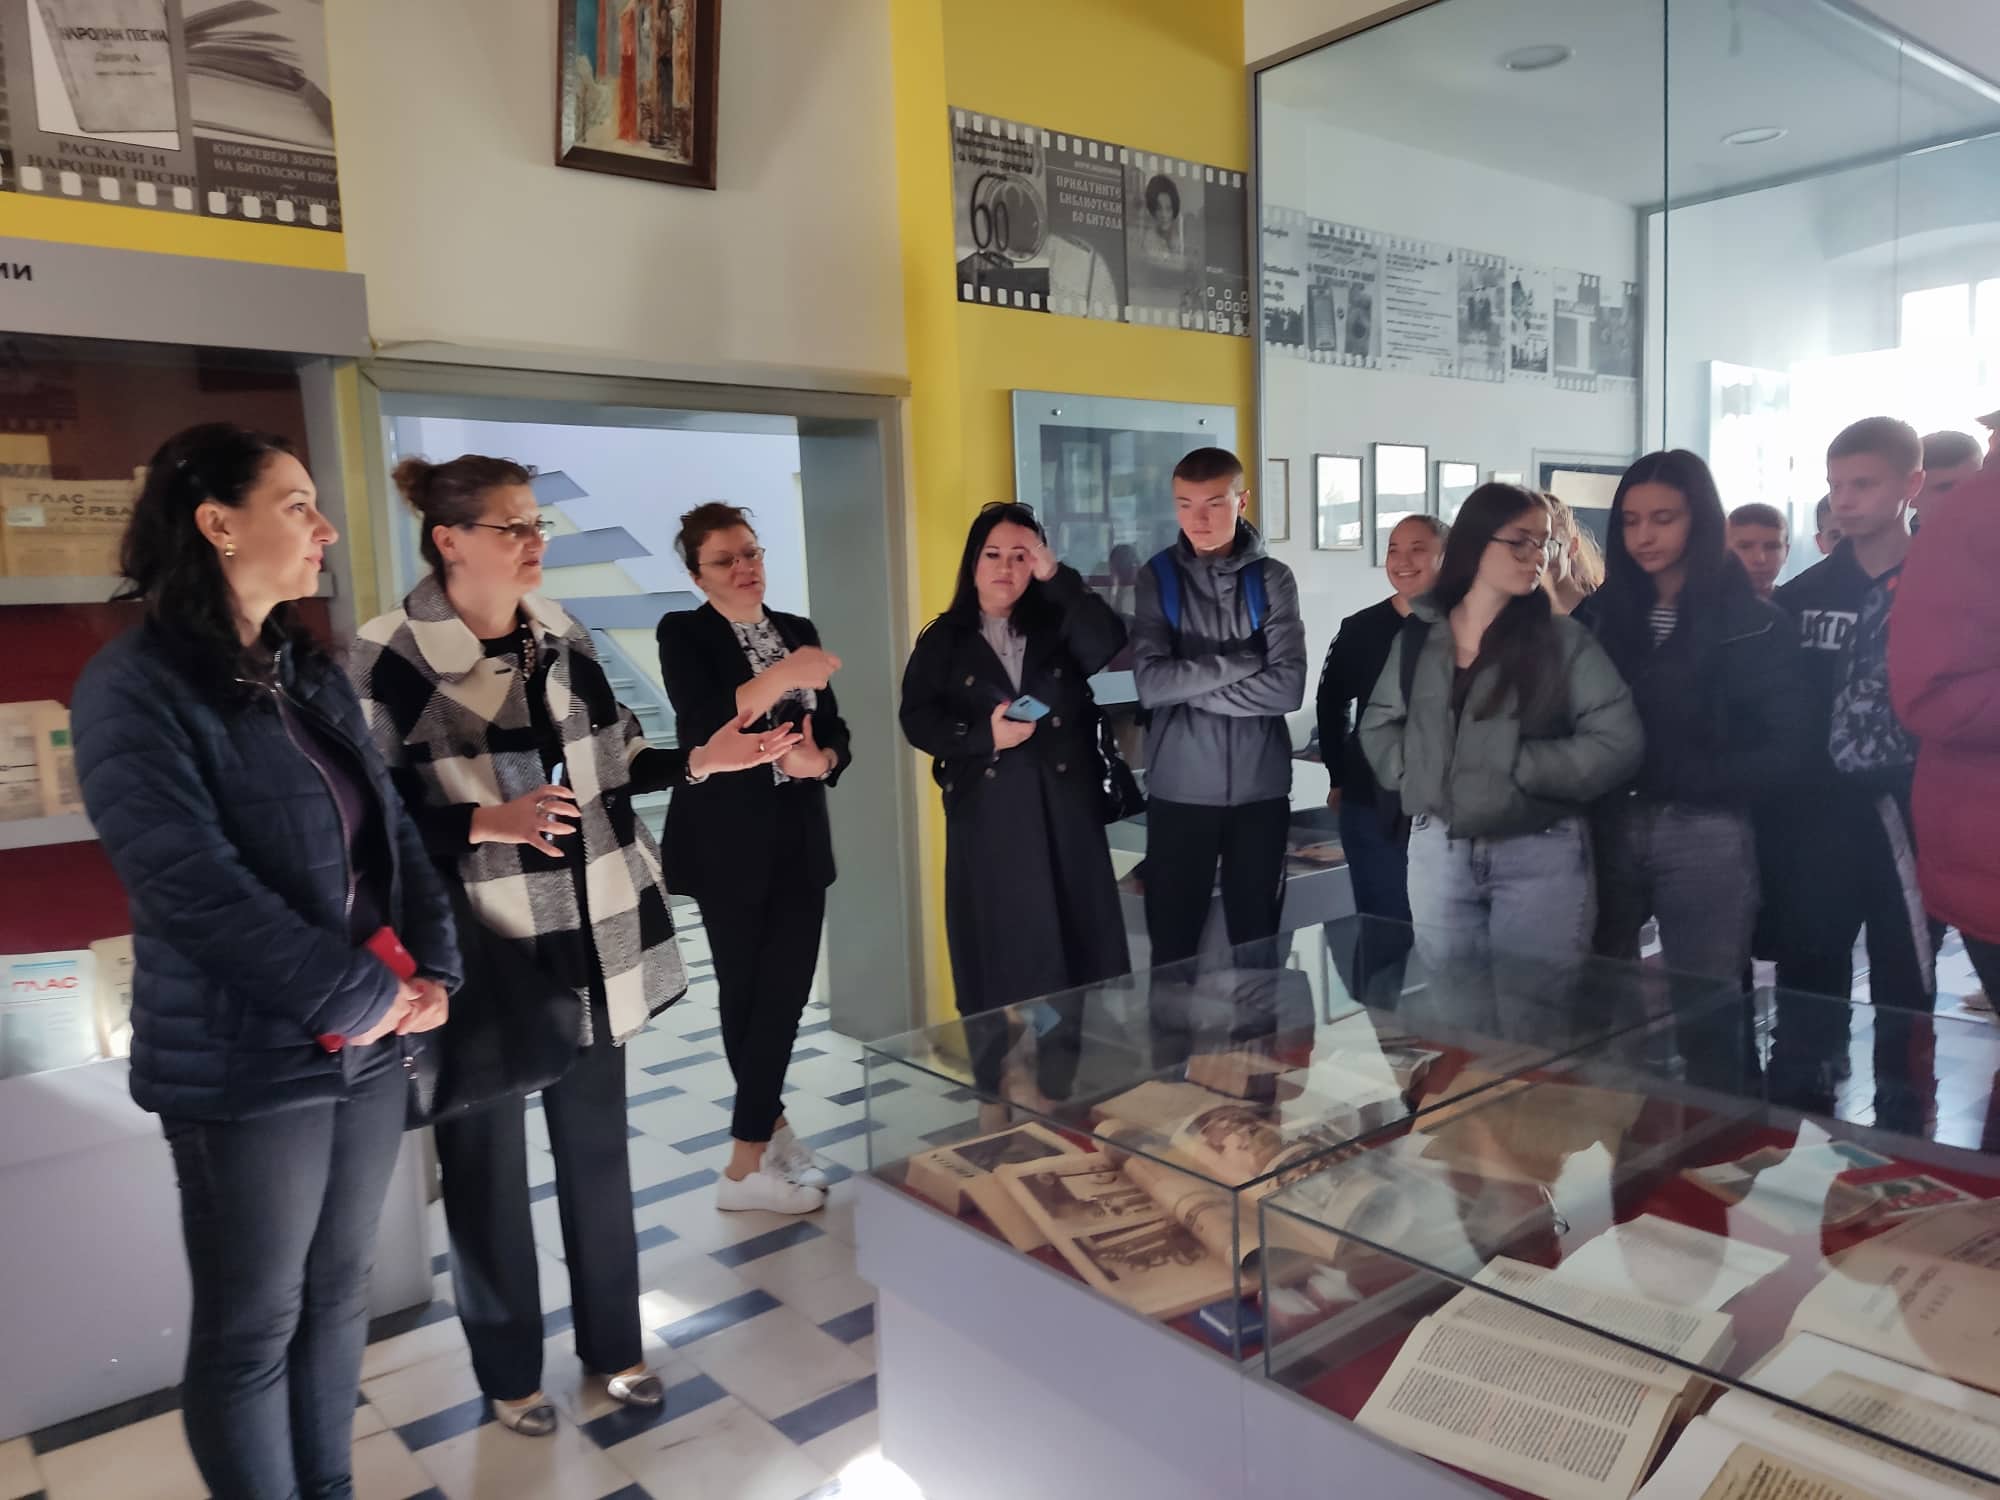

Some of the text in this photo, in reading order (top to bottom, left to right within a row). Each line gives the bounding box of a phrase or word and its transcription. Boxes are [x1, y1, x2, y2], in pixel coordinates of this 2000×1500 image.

[58, 141, 166, 167] РАСКАЗИ И
[212, 144, 288, 164] КНИЖЕВЕН
[214, 160, 233, 171] НА
[236, 161, 305, 180] БИТОЛСКИ
